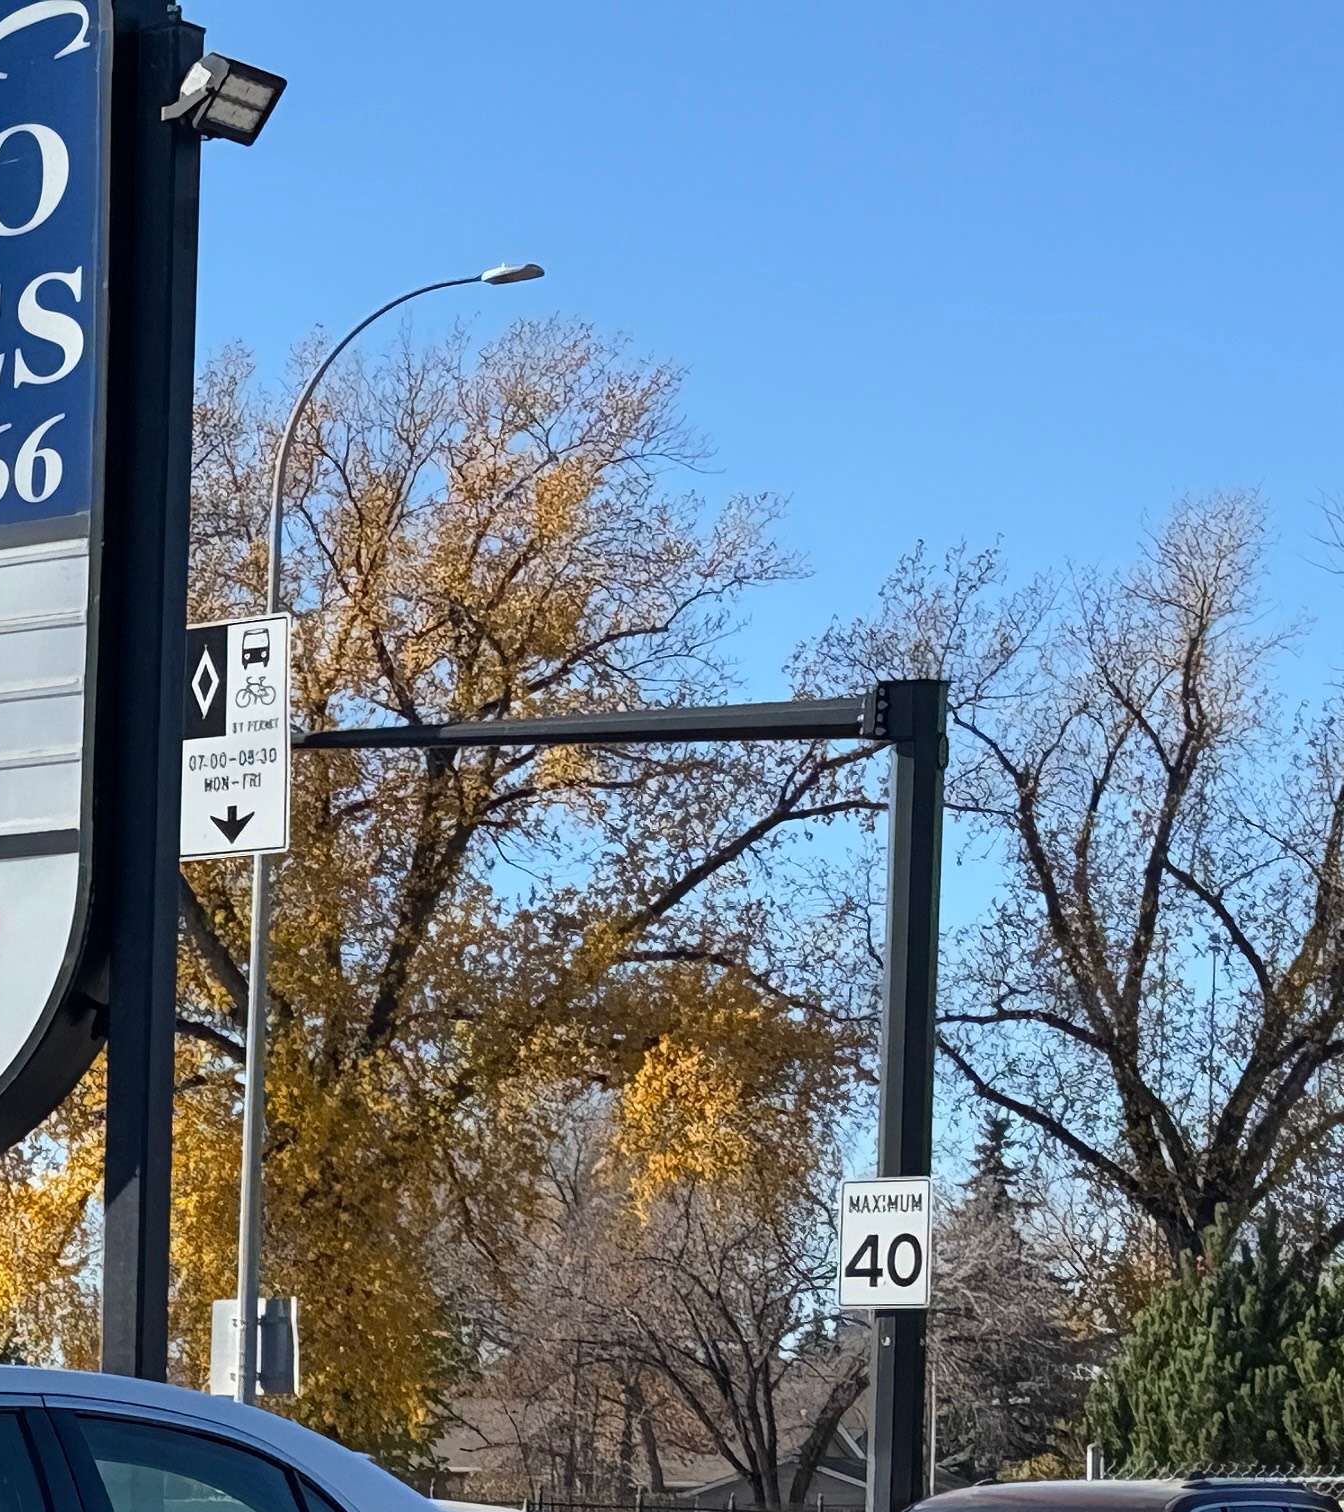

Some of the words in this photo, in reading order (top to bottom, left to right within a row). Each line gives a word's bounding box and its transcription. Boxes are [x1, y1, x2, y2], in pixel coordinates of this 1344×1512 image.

[204, 772, 262, 793] MON-FRI
[848, 1193, 923, 1214] MAXIMUM
[844, 1232, 923, 1288] 40
